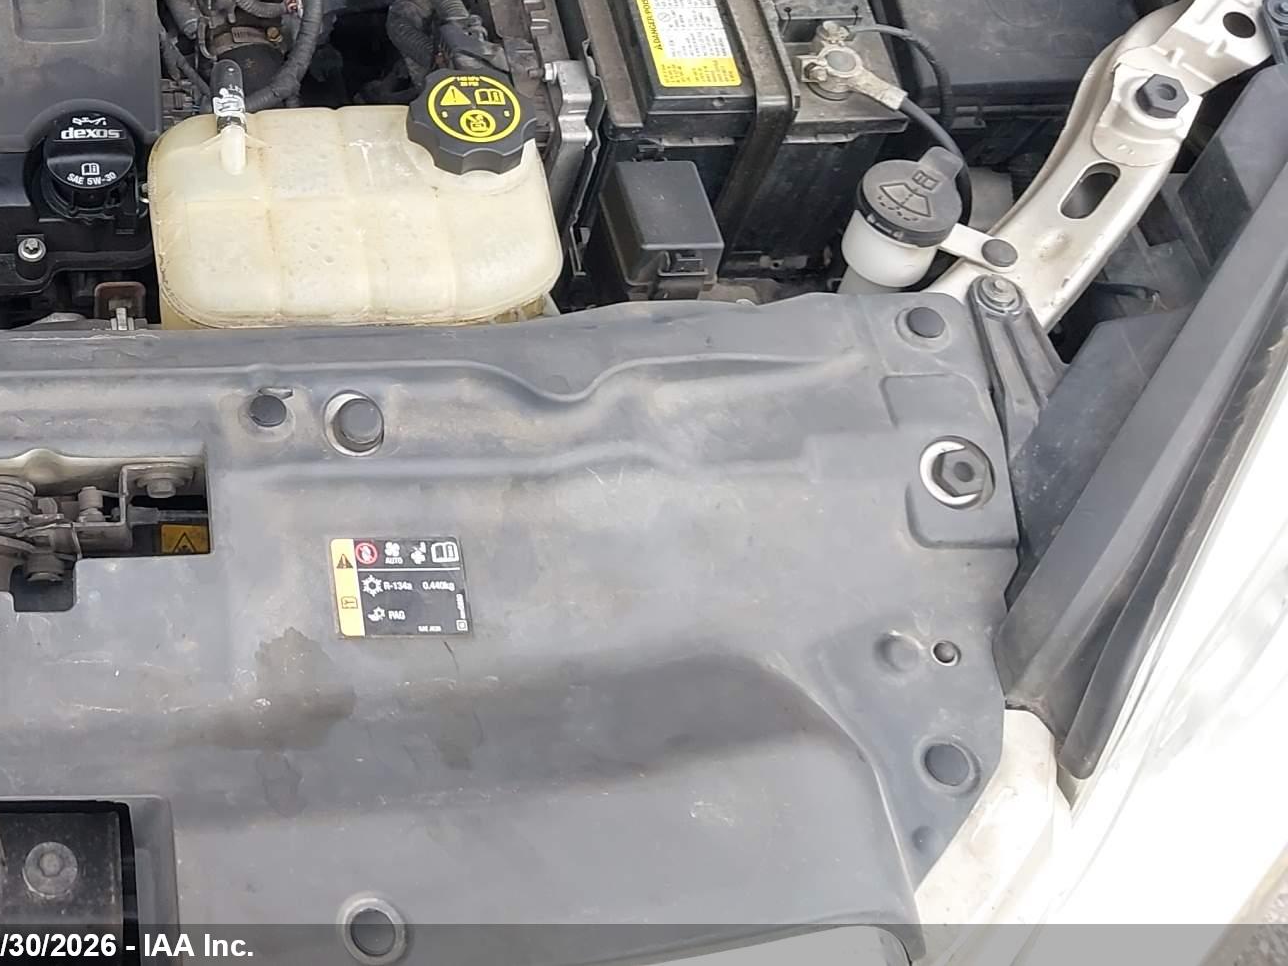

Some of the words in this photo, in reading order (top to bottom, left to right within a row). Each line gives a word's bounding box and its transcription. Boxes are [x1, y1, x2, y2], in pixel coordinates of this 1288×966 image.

[60, 127, 123, 140] dexos
[66, 173, 85, 185] SAE
[86, 171, 117, 186] 5W-30
